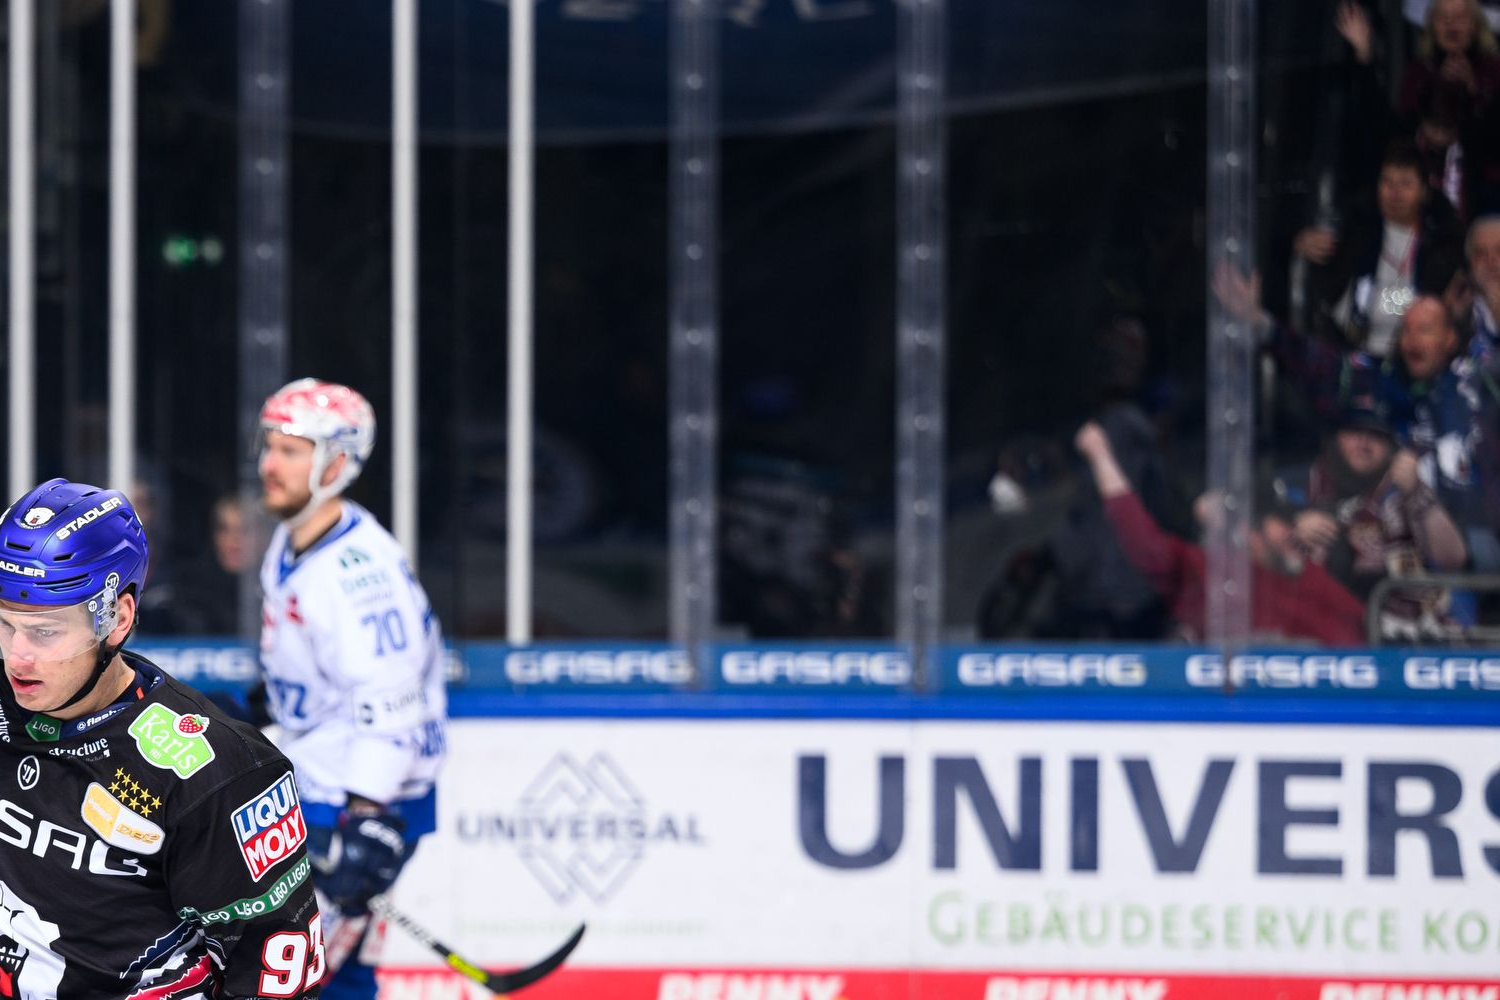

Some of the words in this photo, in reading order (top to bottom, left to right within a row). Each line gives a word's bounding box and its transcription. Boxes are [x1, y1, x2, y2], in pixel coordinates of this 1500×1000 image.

[55, 497, 123, 541] STADLER
[504, 651, 692, 684] GASAG
[722, 651, 911, 685] GASAG
[958, 653, 1147, 687] GASAG
[1186, 655, 1379, 689] GASAG
[32, 720, 56, 735] LIGO
[49, 737, 109, 757] structure
[137, 711, 198, 771] Karls
[235, 777, 297, 844] LIQUI
[456, 810, 708, 848] UNIVERSAL
[795, 754, 1500, 880] UNIVER
[245, 807, 301, 876] MOLY
[269, 881, 288, 907] LIGO
[287, 865, 306, 888] LIGO
[1420, 907, 1500, 955] KO
[257, 911, 327, 998] 93
